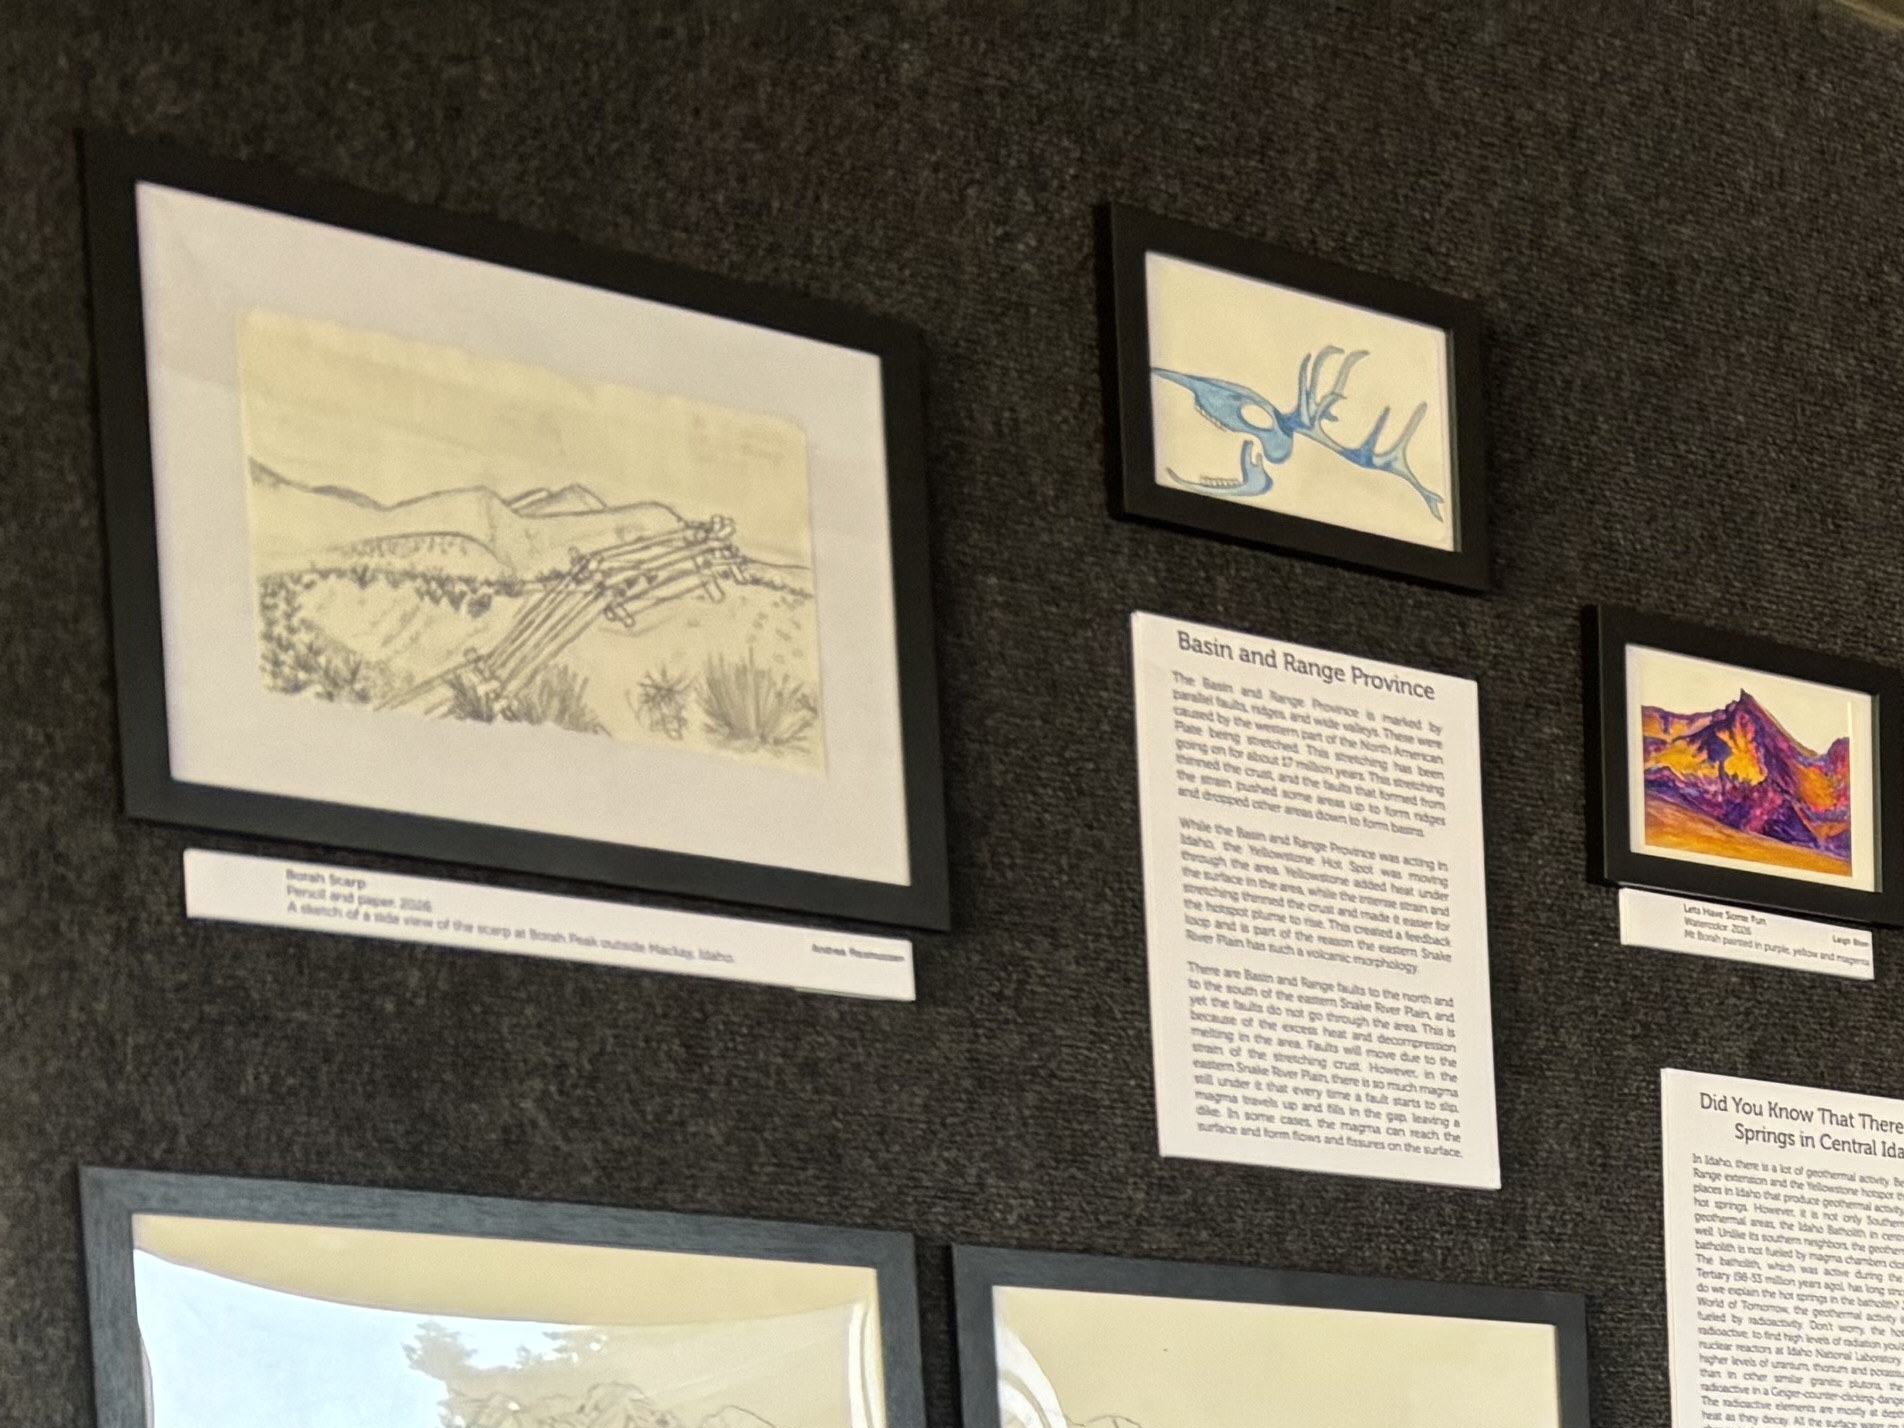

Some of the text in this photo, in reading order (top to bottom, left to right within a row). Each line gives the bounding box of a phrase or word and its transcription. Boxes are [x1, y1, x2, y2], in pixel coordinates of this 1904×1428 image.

[1177, 630, 1434, 699] Basin and Range Province
[1700, 1092, 1728, 1111] Did
[1731, 1096, 1763, 1116] You
[1767, 1101, 1813, 1122] Know
[1817, 1107, 1854, 1127] That
[1858, 1112, 1904, 1134] There
[1734, 1122, 1795, 1148] Springs
[1799, 1130, 1815, 1148] in
[1819, 1133, 1877, 1155] Central
